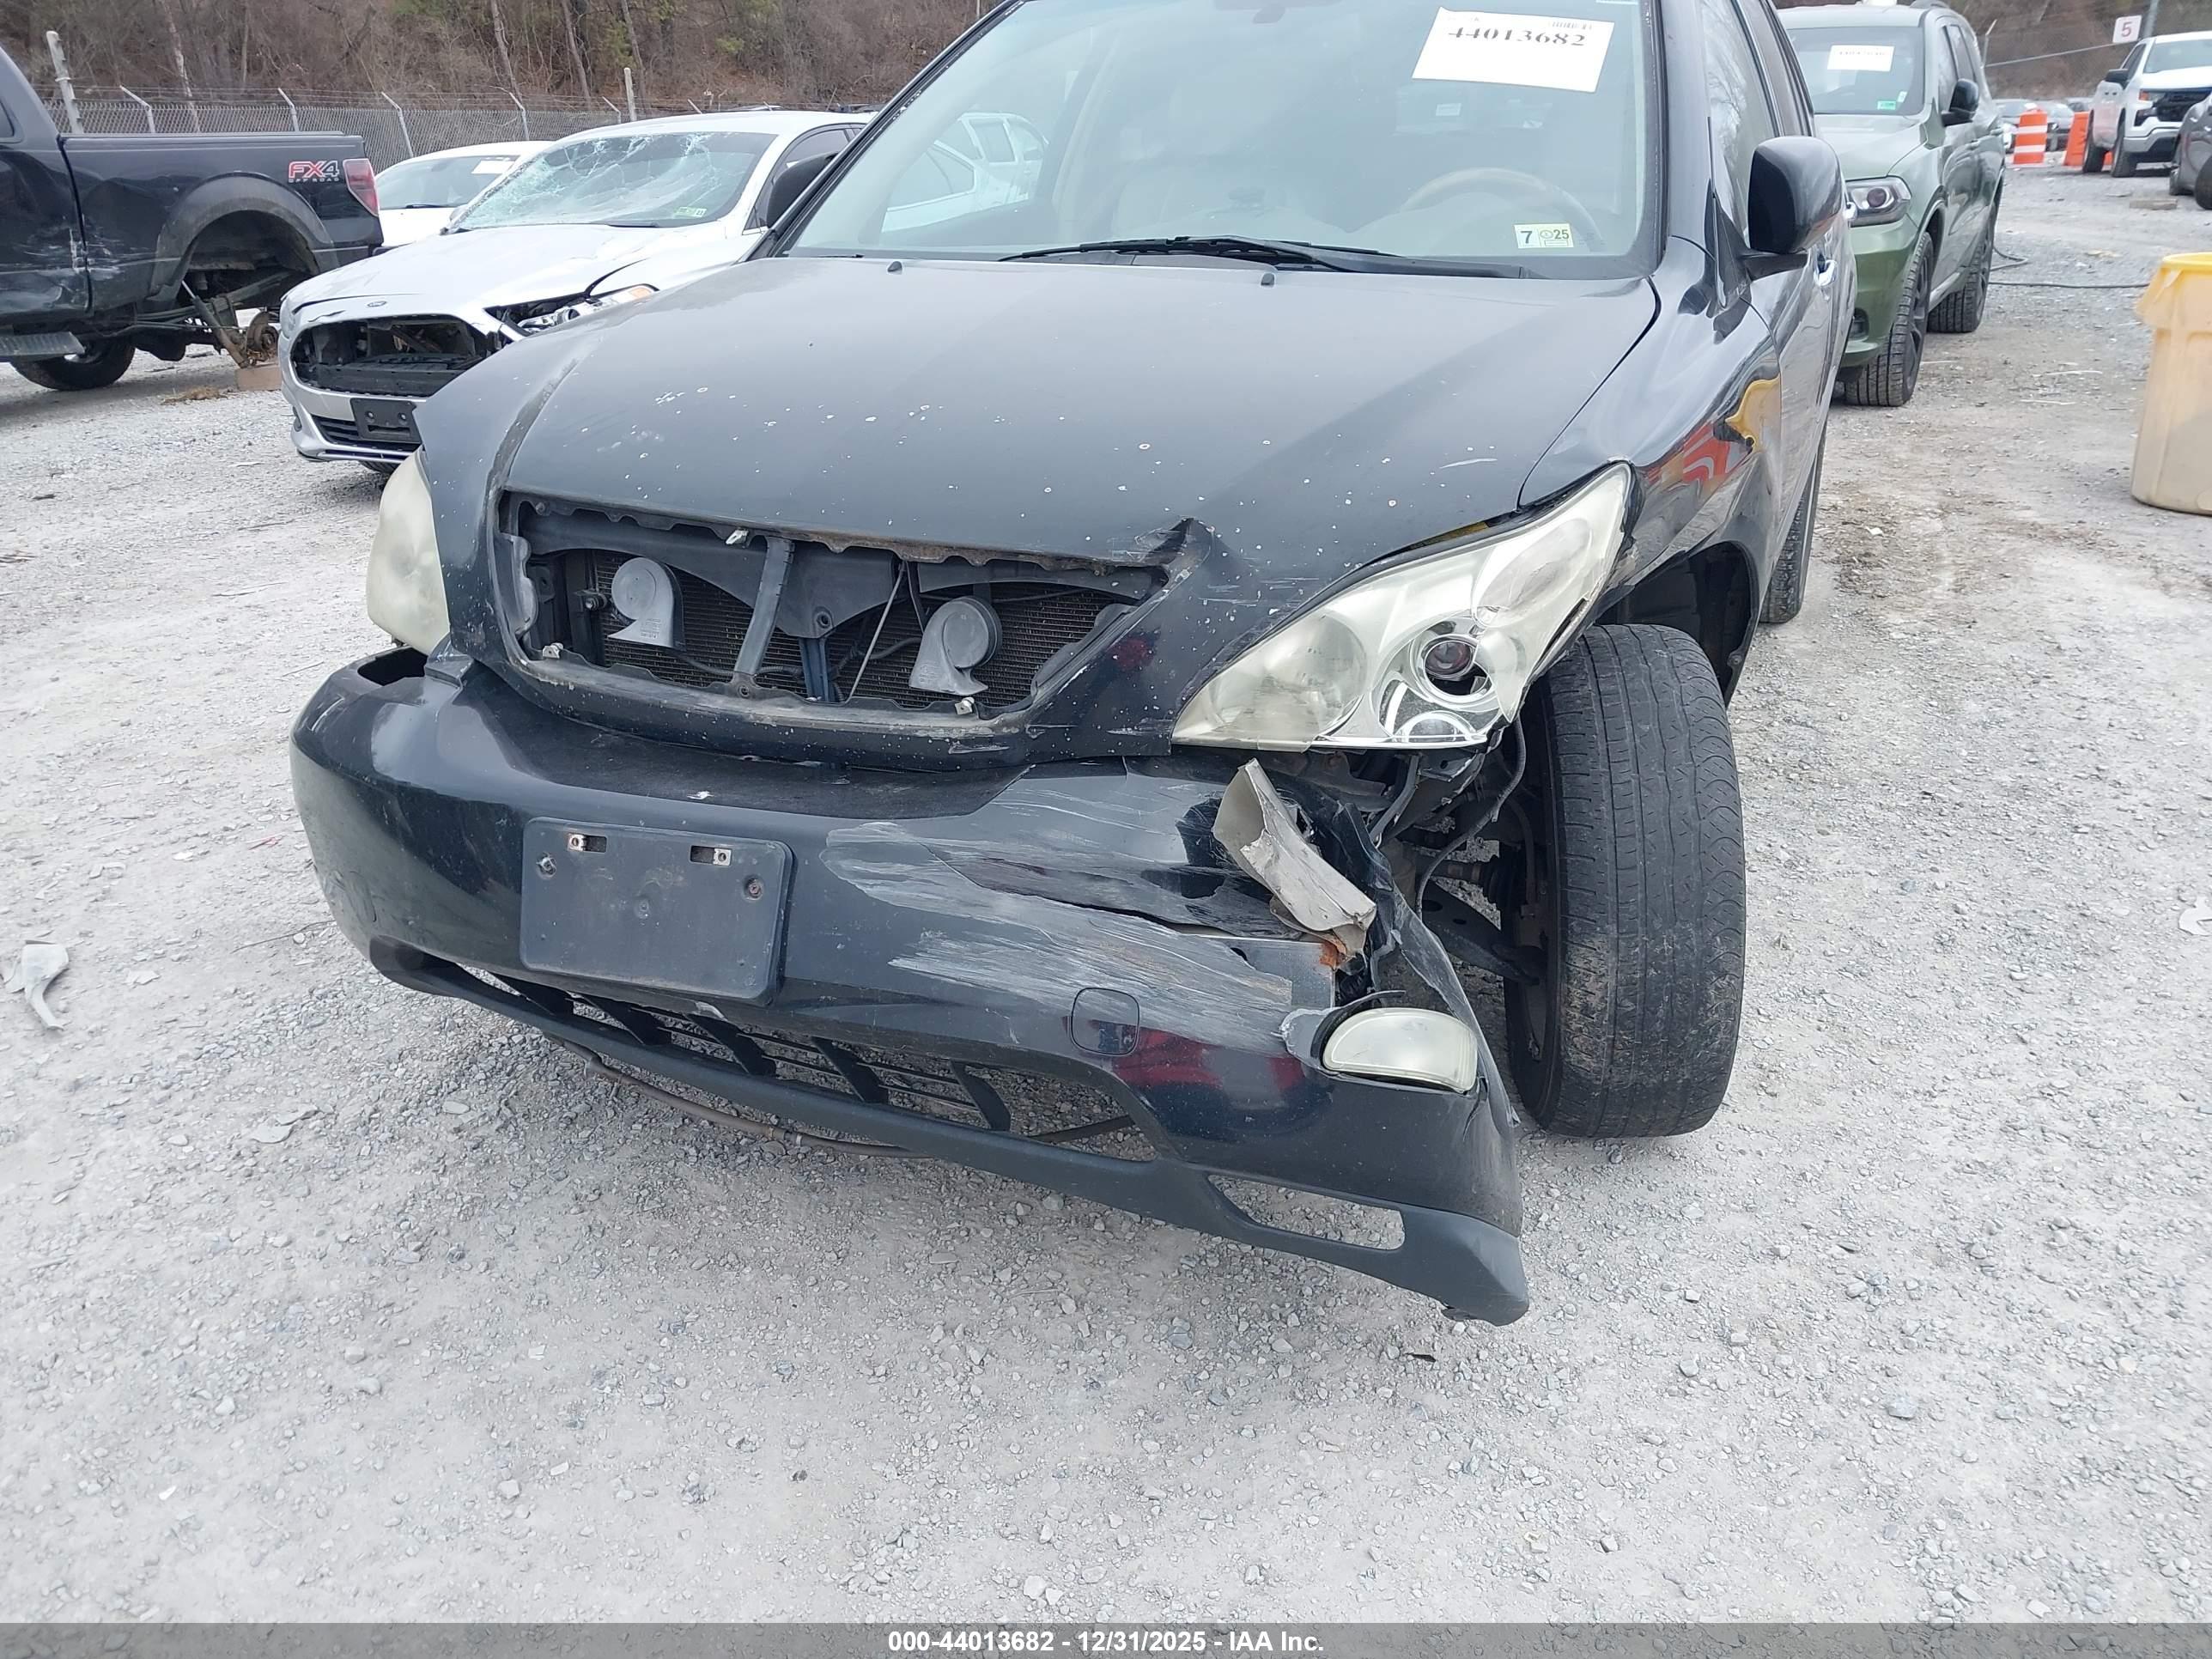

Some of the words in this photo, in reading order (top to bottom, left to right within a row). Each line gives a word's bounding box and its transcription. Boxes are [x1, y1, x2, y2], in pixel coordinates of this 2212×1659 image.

[1448, 27, 1586, 46] 44013682
[2121, 21, 2132, 37] 5
[288, 161, 340, 179] FX4
[1520, 230, 1533, 244] 7
[1553, 228, 1570, 240] 25
